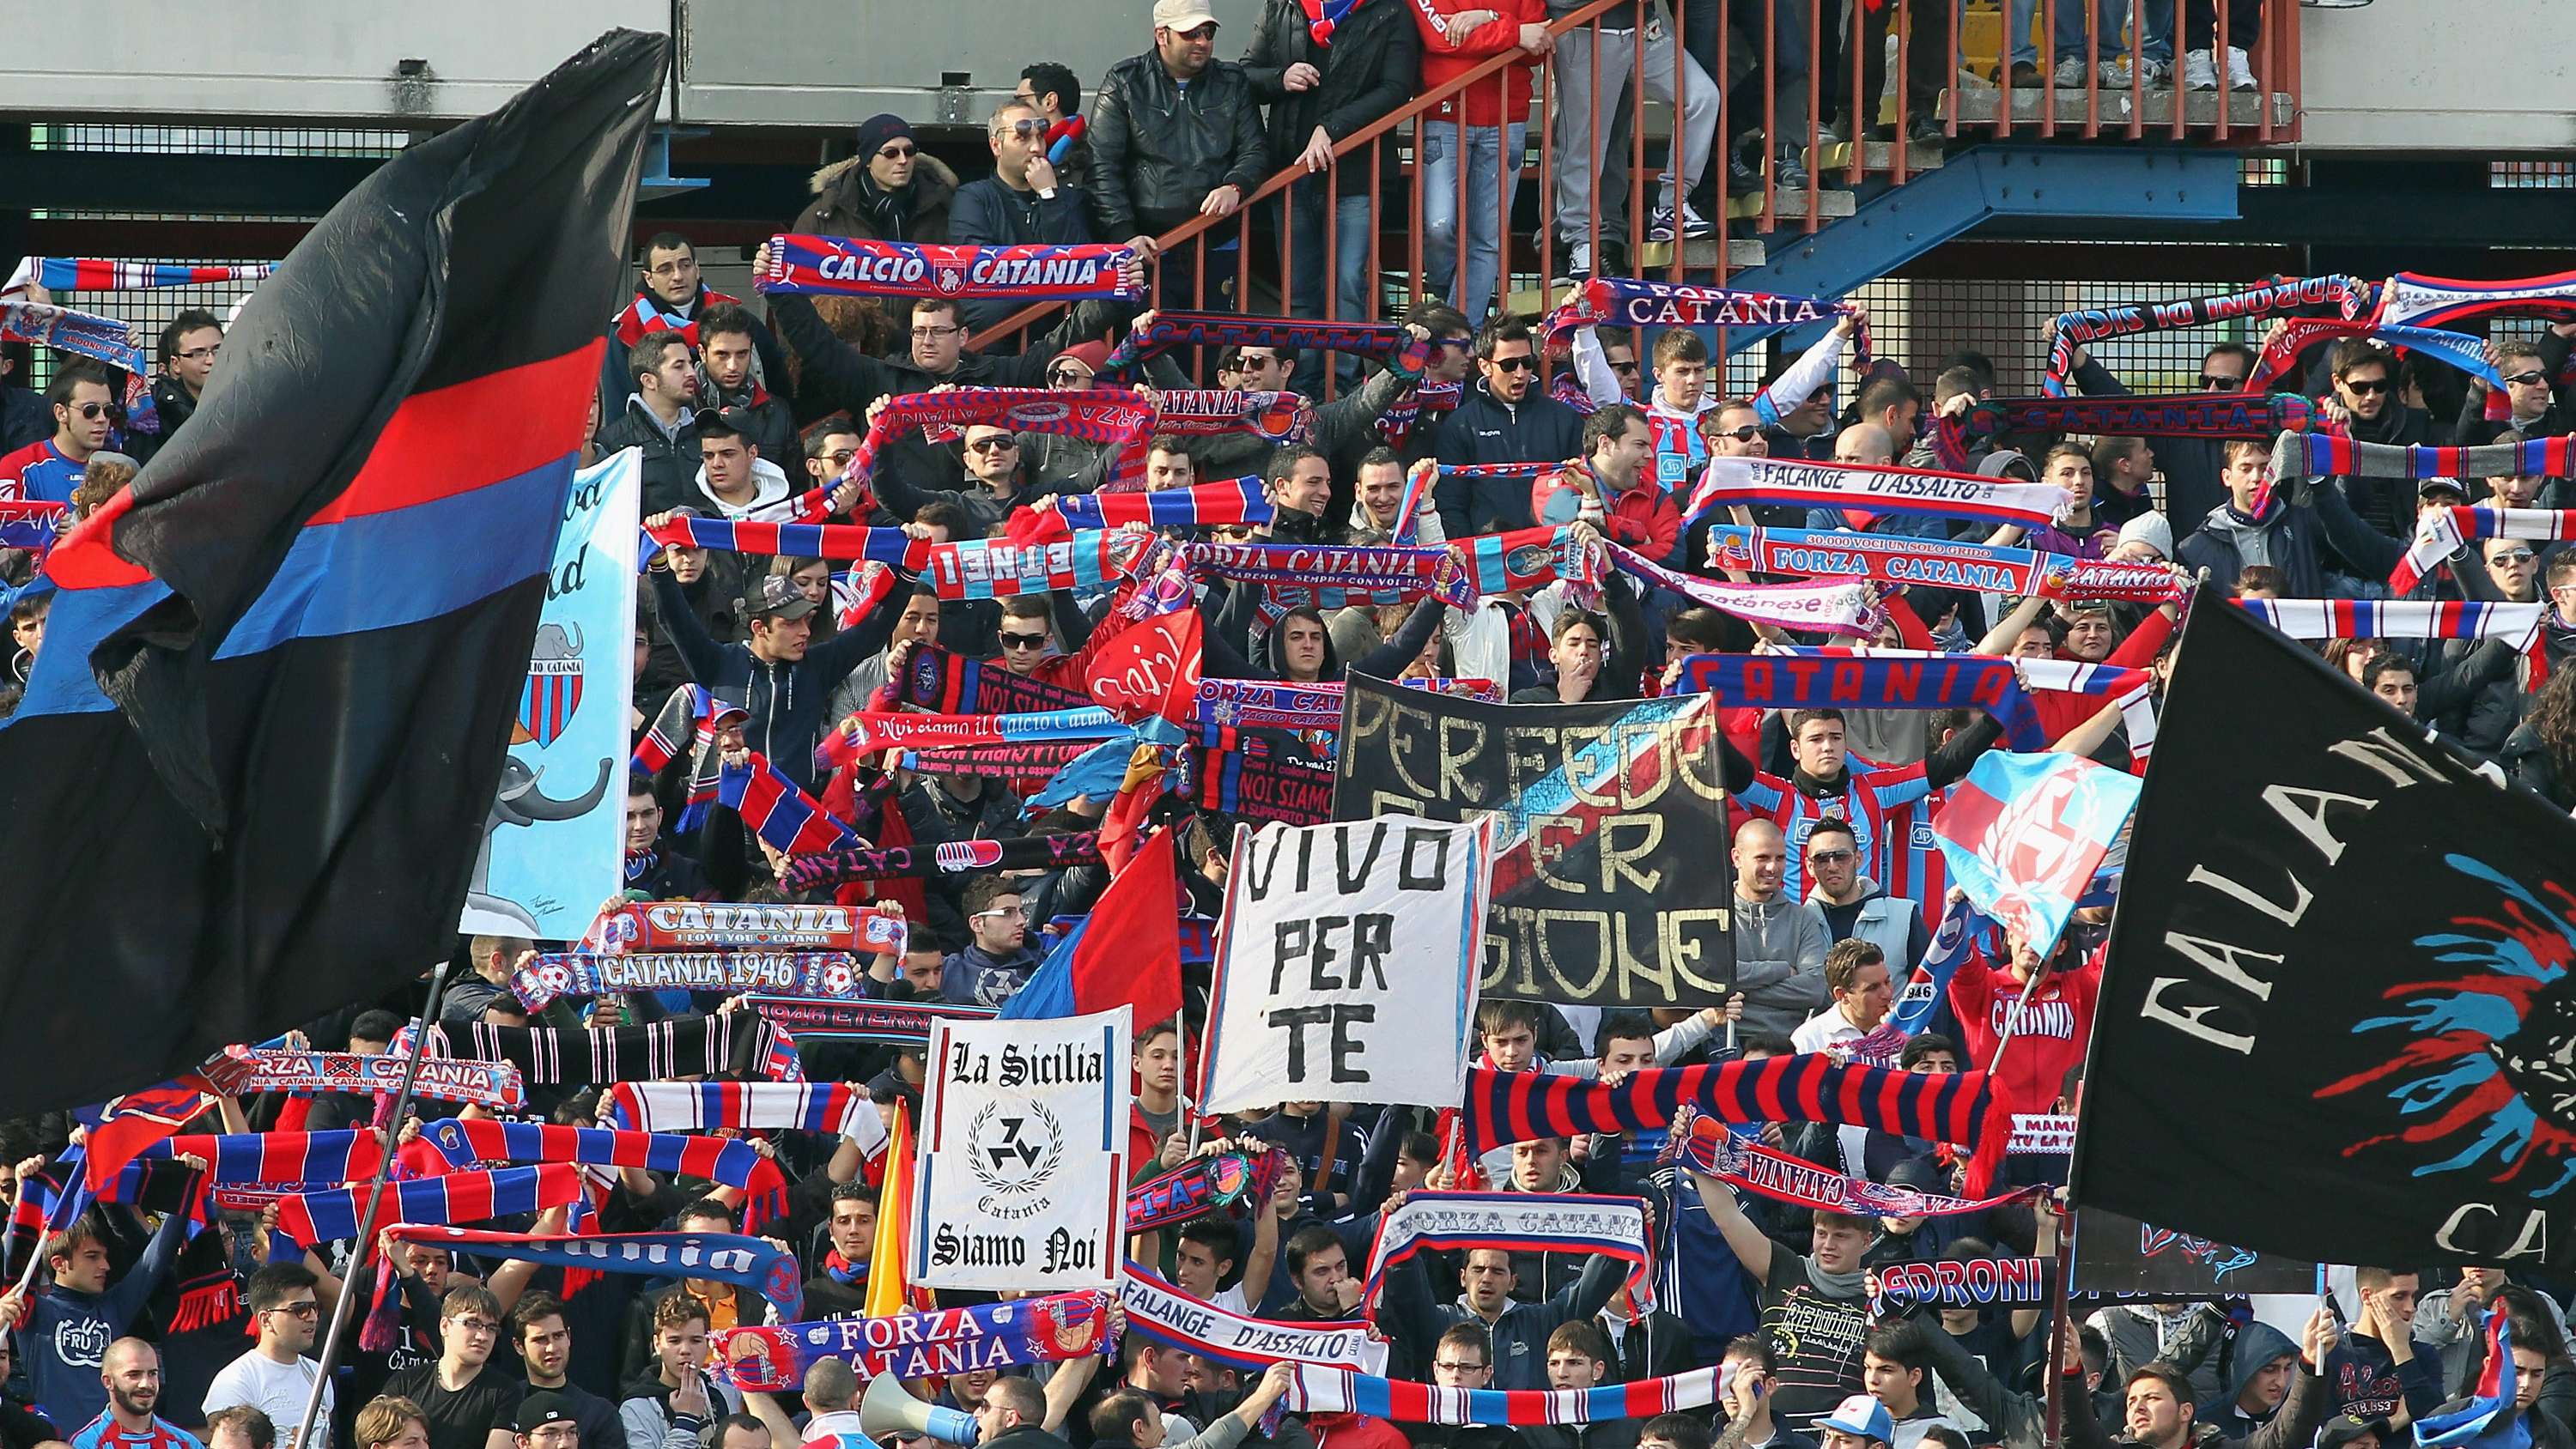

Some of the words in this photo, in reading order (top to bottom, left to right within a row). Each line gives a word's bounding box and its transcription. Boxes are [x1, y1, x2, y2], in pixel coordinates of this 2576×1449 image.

[818, 254, 925, 282] CALCIO
[971, 258, 1097, 285] CATANIA
[1628, 298, 1825, 324] CATANIA
[2153, 300, 2195, 327] DI
[1160, 391, 1242, 415] ATANIA
[1762, 464, 1850, 491] FALANGE
[1867, 471, 1981, 500] D'ASSALTO
[939, 541, 1072, 585] ETNEI
[1182, 543, 1270, 569] ORZA
[1287, 548, 1417, 578] CATANIA
[1807, 534, 1851, 547] 30.000
[1851, 537, 1886, 549] VOCI
[1887, 540, 1907, 551] UN
[1909, 542, 1946, 555] SOLO
[1947, 545, 1993, 558] GRIDO
[1348, 576, 1374, 586] CON
[1378, 578, 1400, 587] VOI
[1772, 548, 1870, 576] FORZA
[1885, 556, 2018, 591] CATANIA
[547, 661, 582, 673] CATANIA
[1690, 659, 2012, 706] CATANIA
[1200, 680, 1276, 708] ORZA
[1345, 686, 1487, 802] PER
[1504, 711, 1726, 811] FEDE
[1247, 822, 1453, 903] VIVO
[2138, 725, 2454, 1057] FALAN
[645, 906, 852, 933] CATANIA
[686, 933, 724, 943] LOVE
[726, 933, 756, 943] YOU
[772, 933, 830, 943] CATANIA
[1268, 912, 1395, 996] PER
[601, 953, 727, 986] CATANIA
[730, 953, 796, 988] 1946
[805, 955, 822, 994] FORZA
[1907, 985, 1931, 998] 946
[831, 1005, 933, 1031] ETERN
[1267, 1003, 1376, 1084] TE
[257, 1056, 316, 1076] RZA
[370, 1058, 492, 1091] CAANIA
[950, 1041, 989, 1085] La
[999, 1041, 1103, 1088] Sicilia
[332, 1079, 380, 1088] CATANIA
[386, 1080, 434, 1093] CANIA
[440, 1086, 486, 1100] CATANIA
[1748, 1150, 1848, 1206] CATANIA
[977, 1193, 1052, 1221] Catania
[1516, 1211, 1645, 1241] CATANI
[931, 1221, 1026, 1267] Siamo
[1039, 1225, 1099, 1275] Noi
[838, 1307, 984, 1351] FORZA
[1121, 1280, 1216, 1339] FALANGE
[1232, 1325, 1349, 1359] D'ASSALTO
[817, 1336, 1014, 1382] ATANIA
